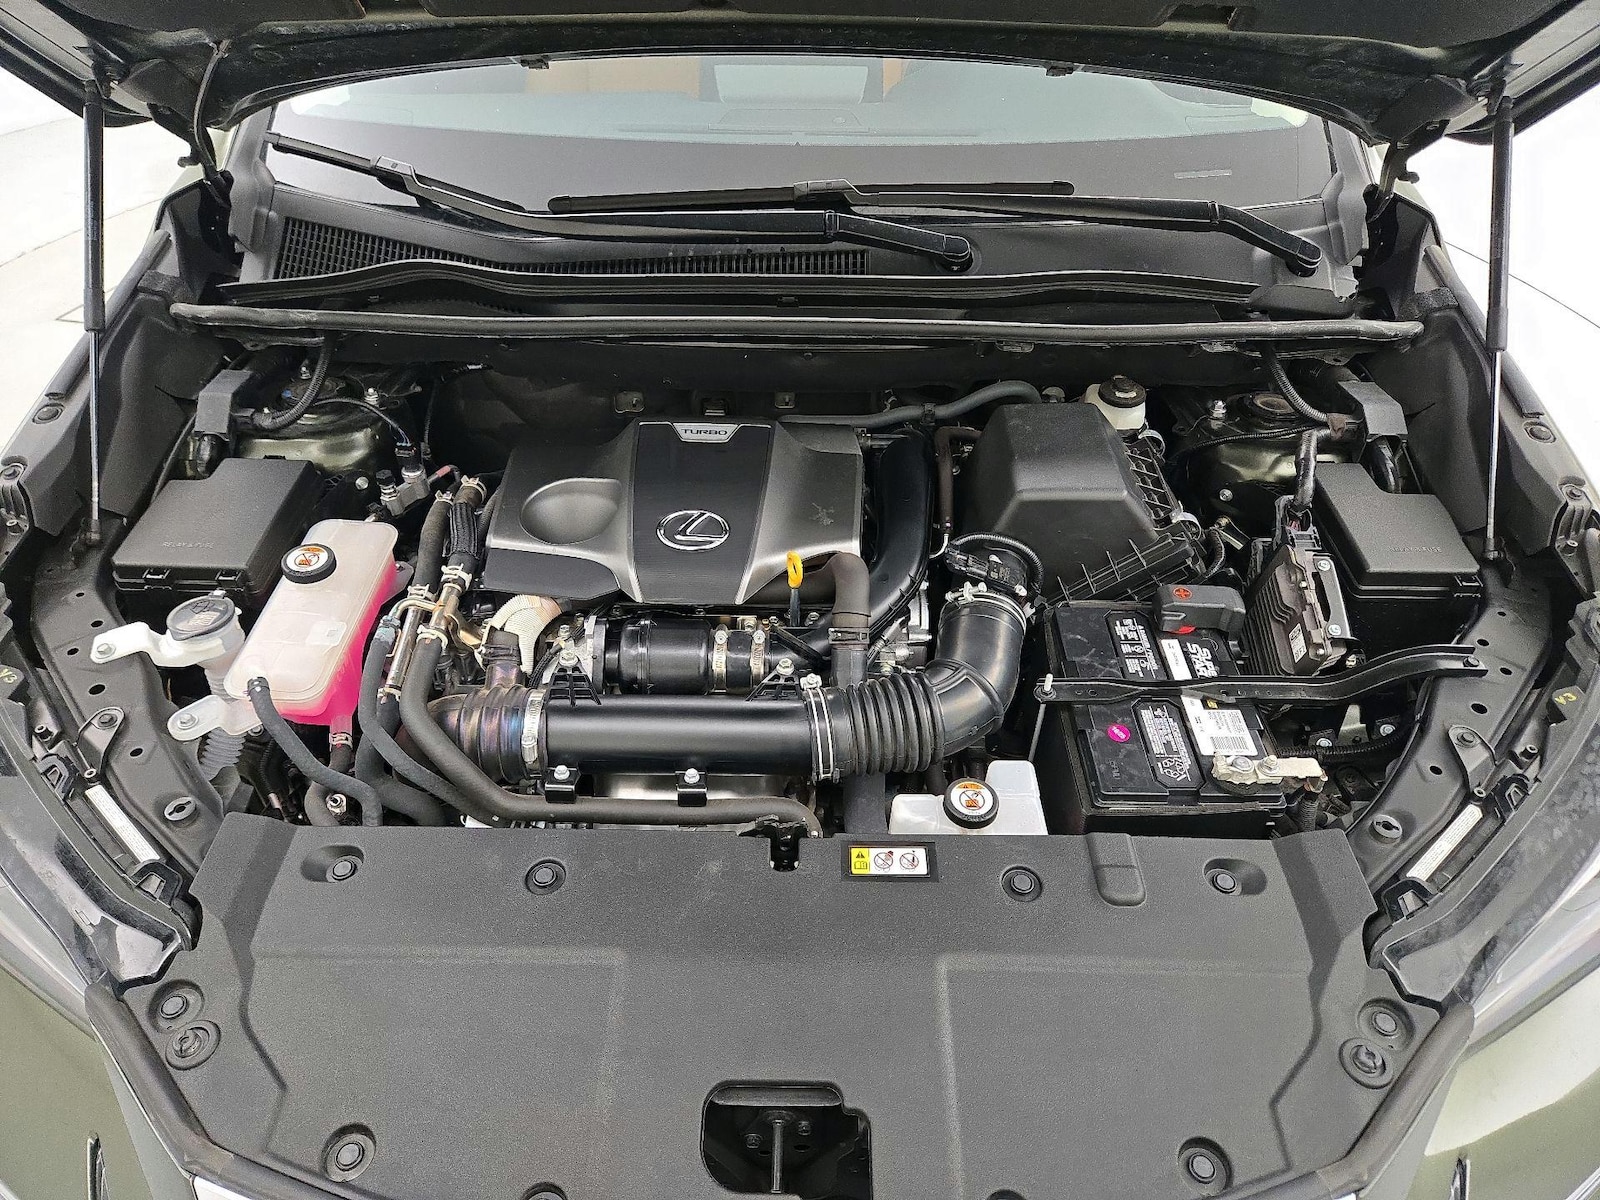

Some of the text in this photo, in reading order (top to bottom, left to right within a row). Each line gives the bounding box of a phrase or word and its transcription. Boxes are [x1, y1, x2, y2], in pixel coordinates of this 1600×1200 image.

[681, 428, 728, 436] TURBO
[1186, 641, 1210, 678] STAR
[1200, 647, 1218, 677] SUPE
